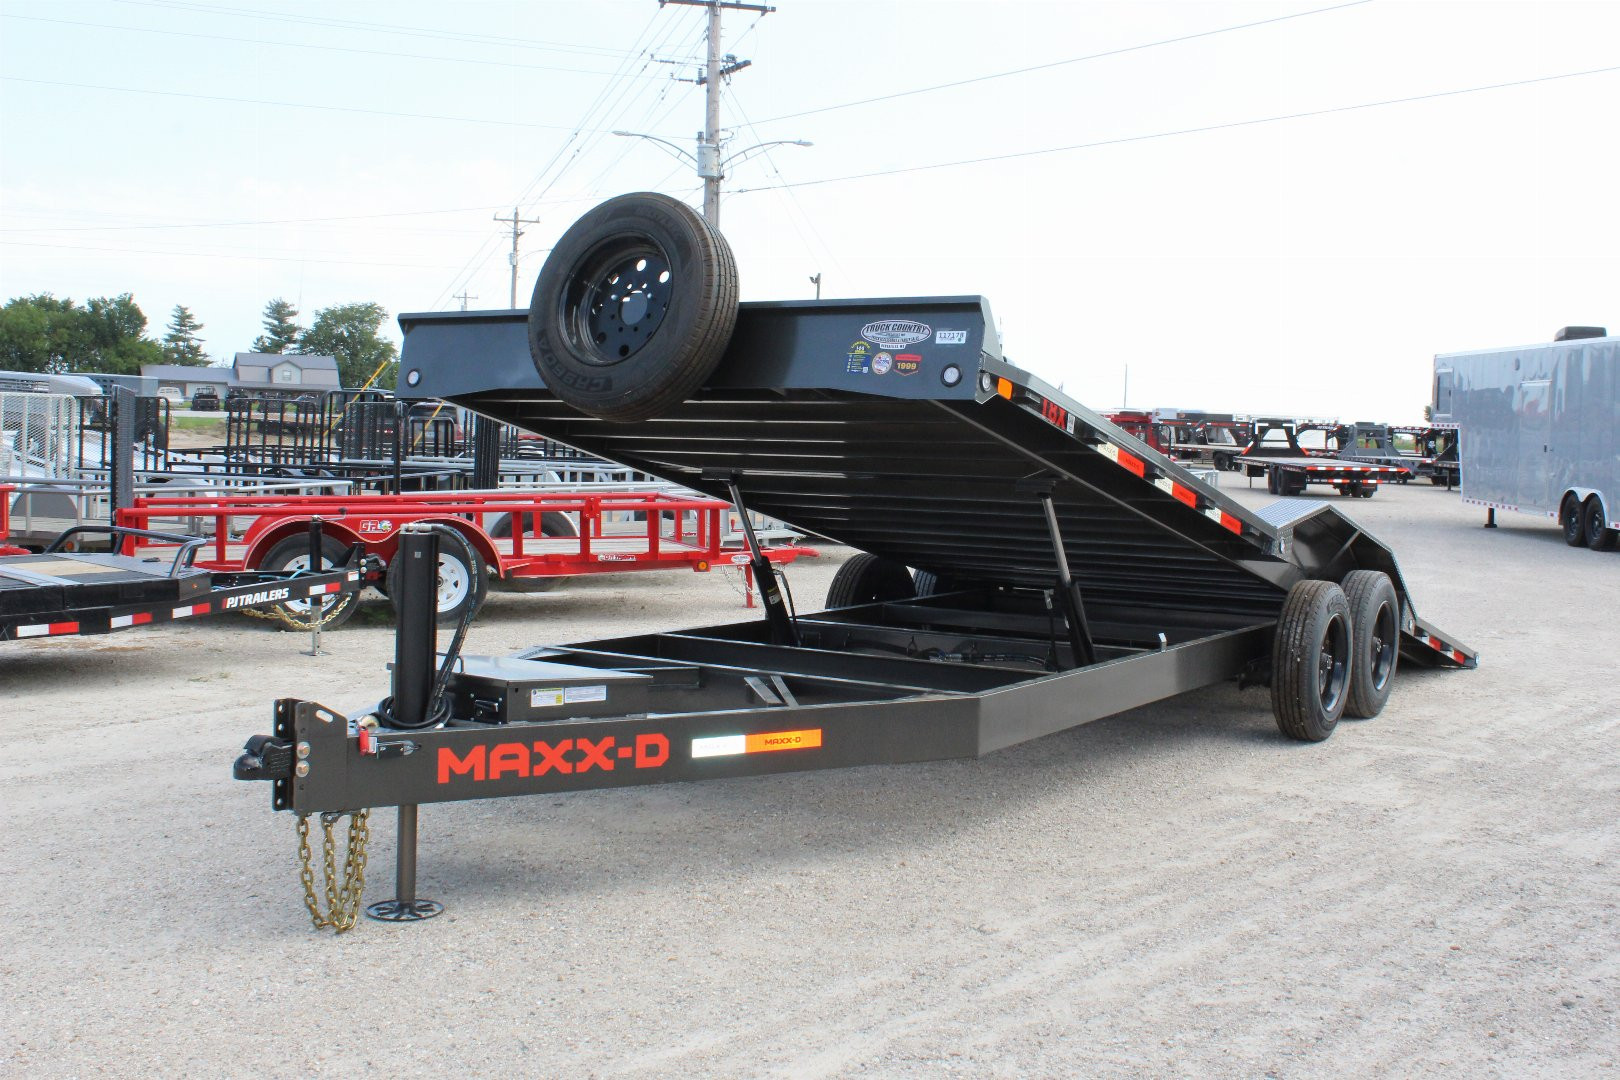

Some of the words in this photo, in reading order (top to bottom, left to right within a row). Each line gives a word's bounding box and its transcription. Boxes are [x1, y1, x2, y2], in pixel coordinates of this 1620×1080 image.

[865, 323, 895, 334] TRUCK
[894, 323, 928, 334] COUNTRY
[896, 362, 917, 370] 1999
[226, 596, 239, 609] PJ
[239, 587, 290, 607] TRAILERS
[764, 736, 801, 746] MAXX-D
[437, 733, 670, 785] MAXX-D
